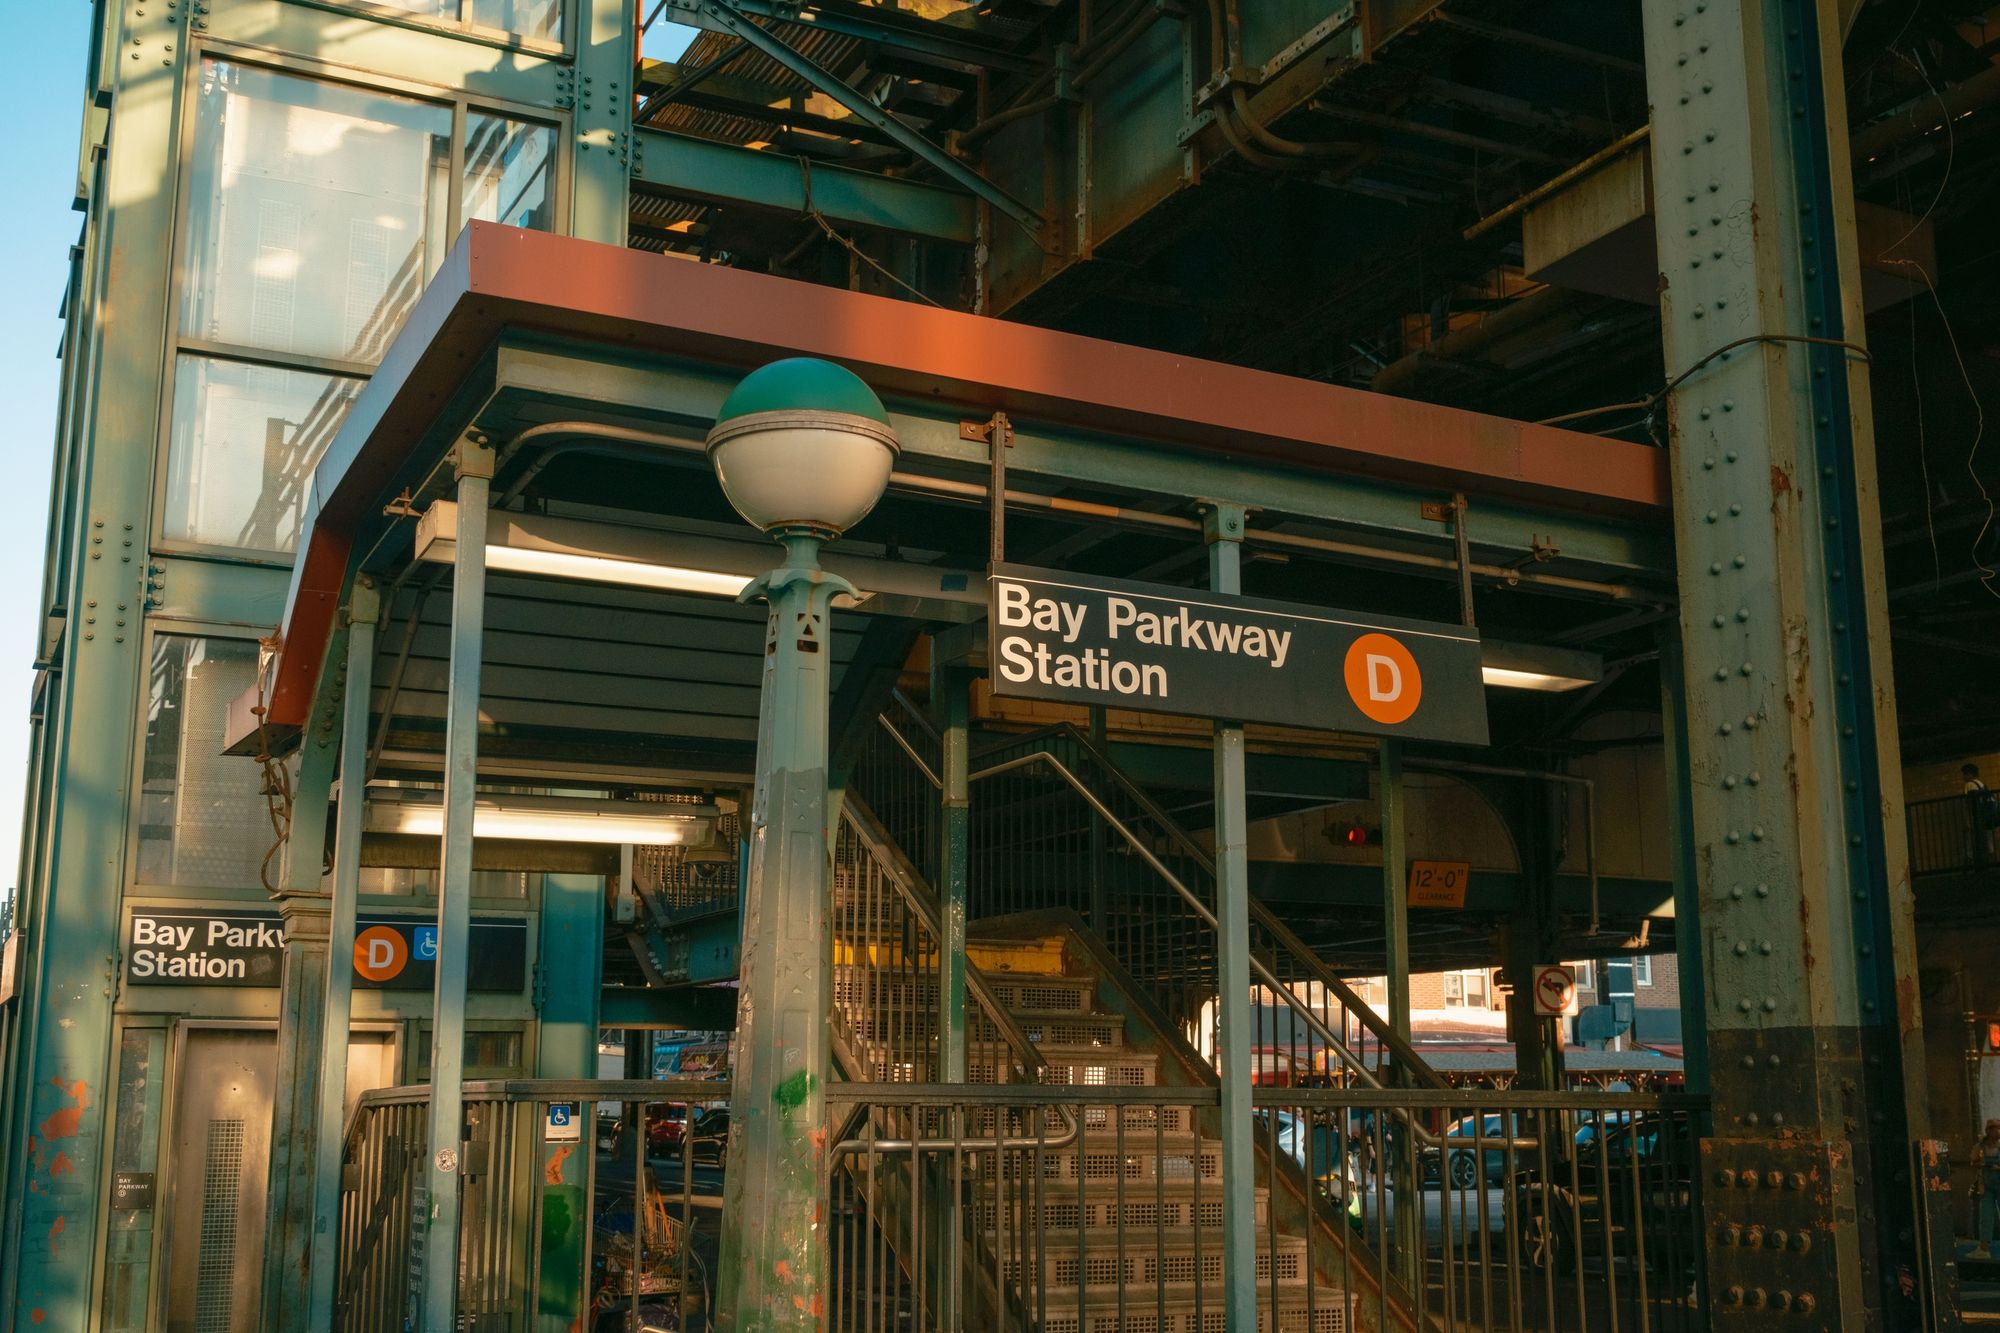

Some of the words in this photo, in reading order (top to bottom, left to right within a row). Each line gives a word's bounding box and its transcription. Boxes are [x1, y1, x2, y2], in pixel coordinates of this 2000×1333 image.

[999, 582, 1087, 642] Bay
[1108, 597, 1292, 668] Parkway
[999, 637, 1168, 697] Station
[1366, 653, 1402, 703] D
[133, 918, 195, 951] Bay
[368, 939, 394, 968] D
[131, 949, 246, 978] Station
